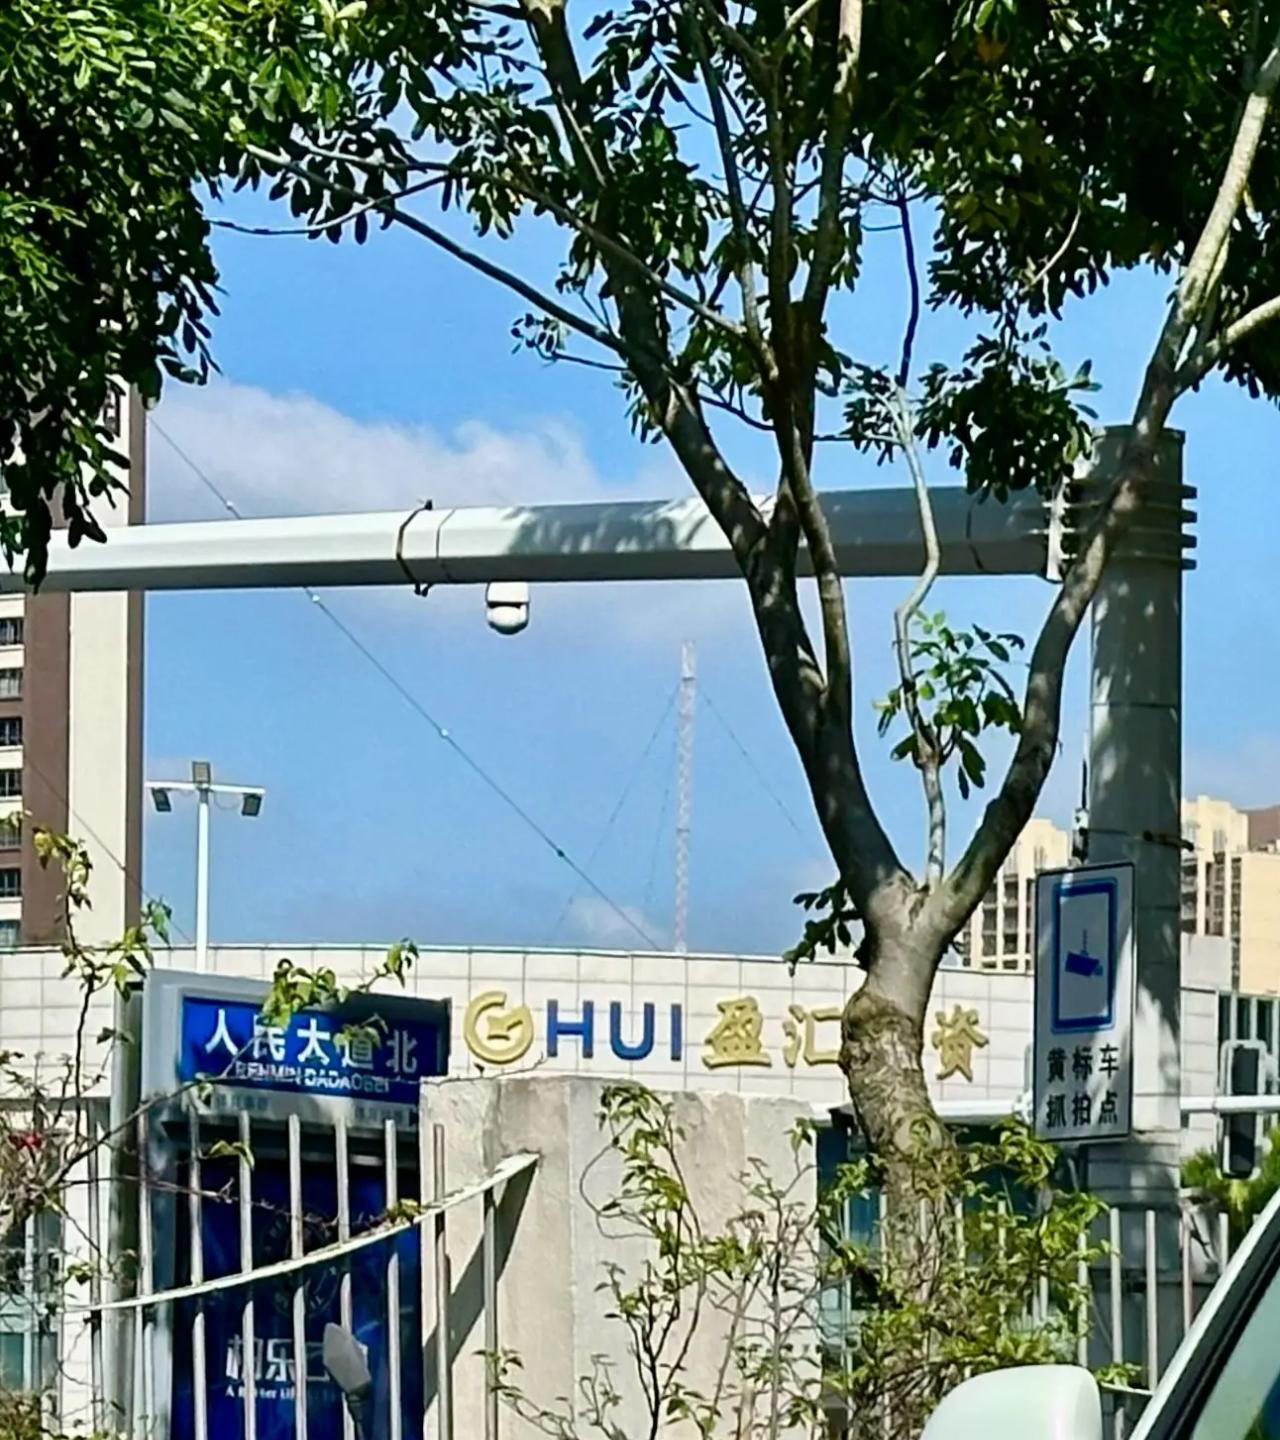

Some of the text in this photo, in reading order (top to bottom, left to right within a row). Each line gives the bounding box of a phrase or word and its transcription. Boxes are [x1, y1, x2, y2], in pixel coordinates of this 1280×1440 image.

[701, 996, 988, 1083] 盈汇资
[1046, 1044, 1119, 1083] 黄标车
[1046, 1090, 1119, 1128] 抓拍点
